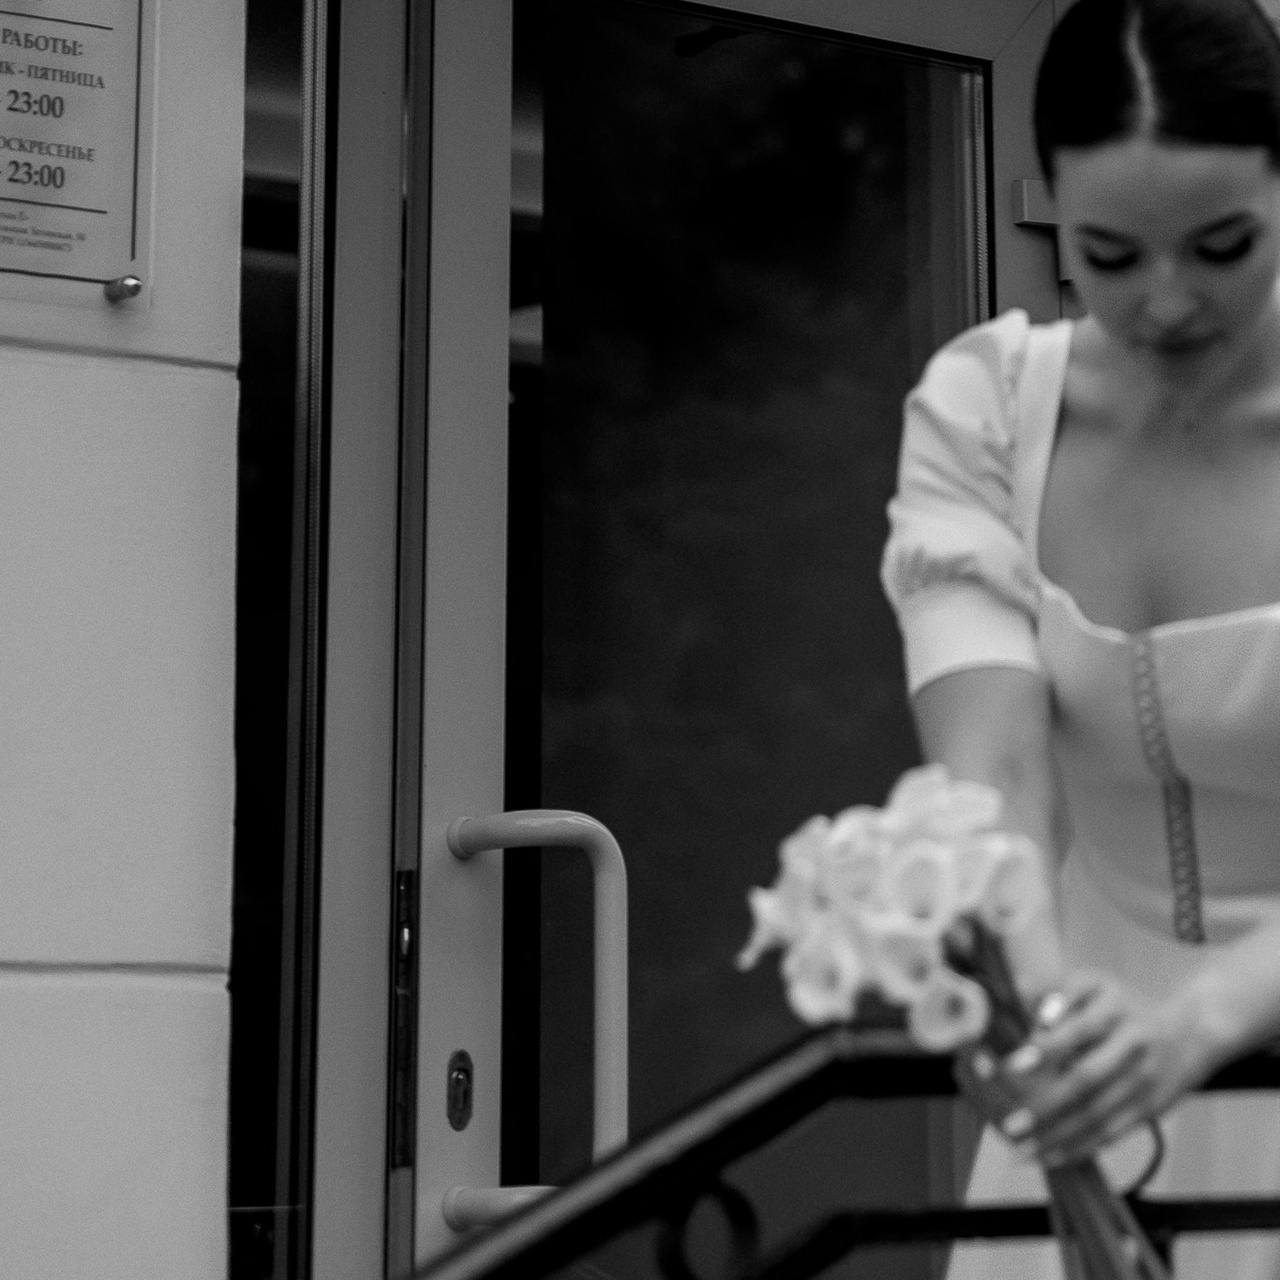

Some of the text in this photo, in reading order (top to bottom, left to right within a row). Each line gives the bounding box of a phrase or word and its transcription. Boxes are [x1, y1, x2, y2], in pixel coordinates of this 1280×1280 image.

[2, 27, 83, 56] РАБОТЫ:
[27, 64, 105, 88] ПЯТНИЦА
[7, 89, 64, 118] 23:00
[7, 160, 65, 189] 23:00
